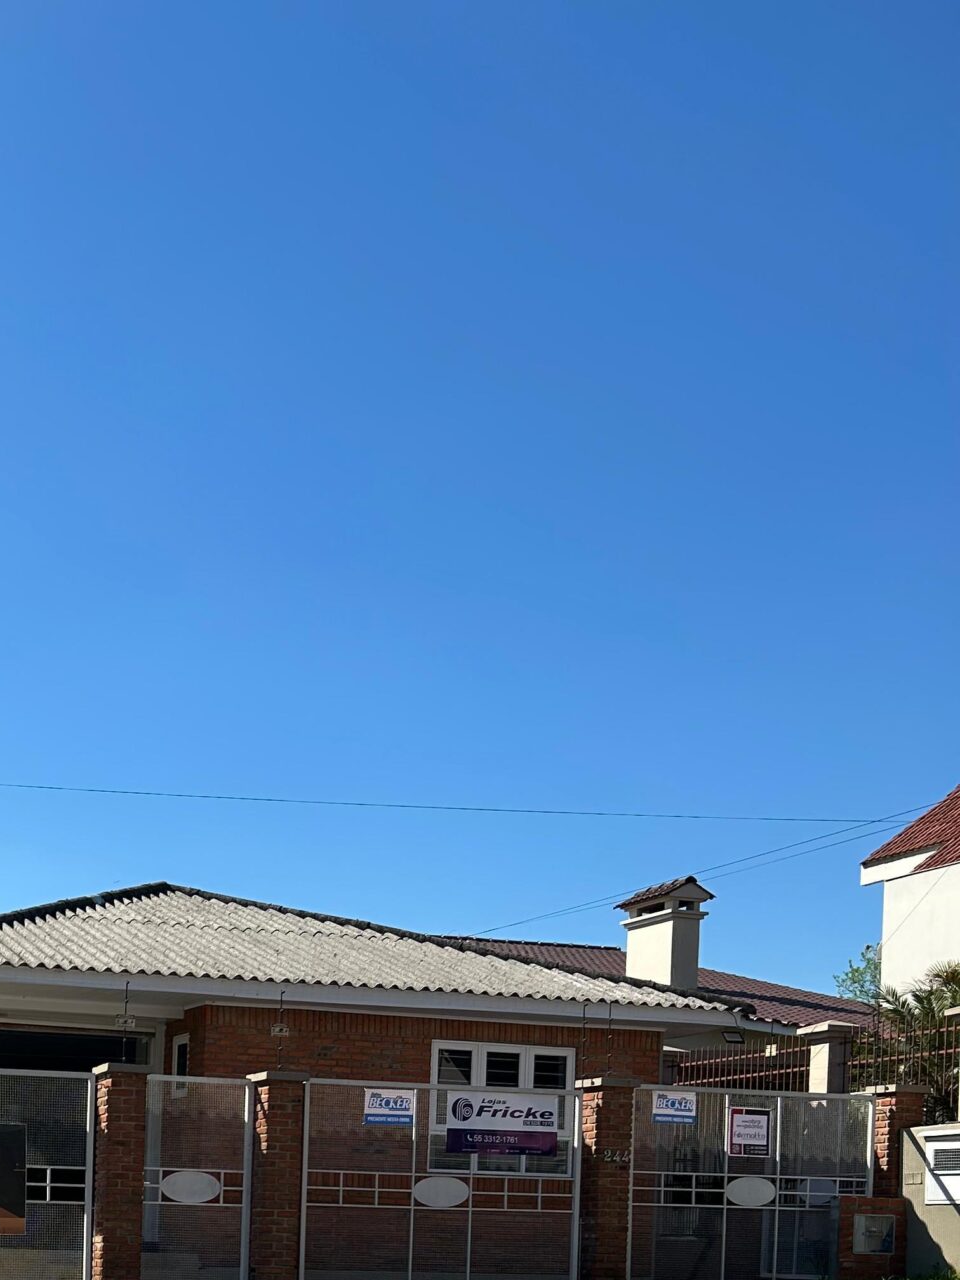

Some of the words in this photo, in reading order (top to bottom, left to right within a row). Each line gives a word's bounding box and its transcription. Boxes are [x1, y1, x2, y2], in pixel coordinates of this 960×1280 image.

[368, 1097, 411, 1109] BECKER
[481, 1098, 507, 1106] Lojas
[656, 1098, 694, 1110] BECKER
[476, 1105, 554, 1120] Fricke
[473, 1134, 482, 1142] 55
[483, 1135, 518, 1144] 3312-1761
[604, 1149, 630, 1162] 244
